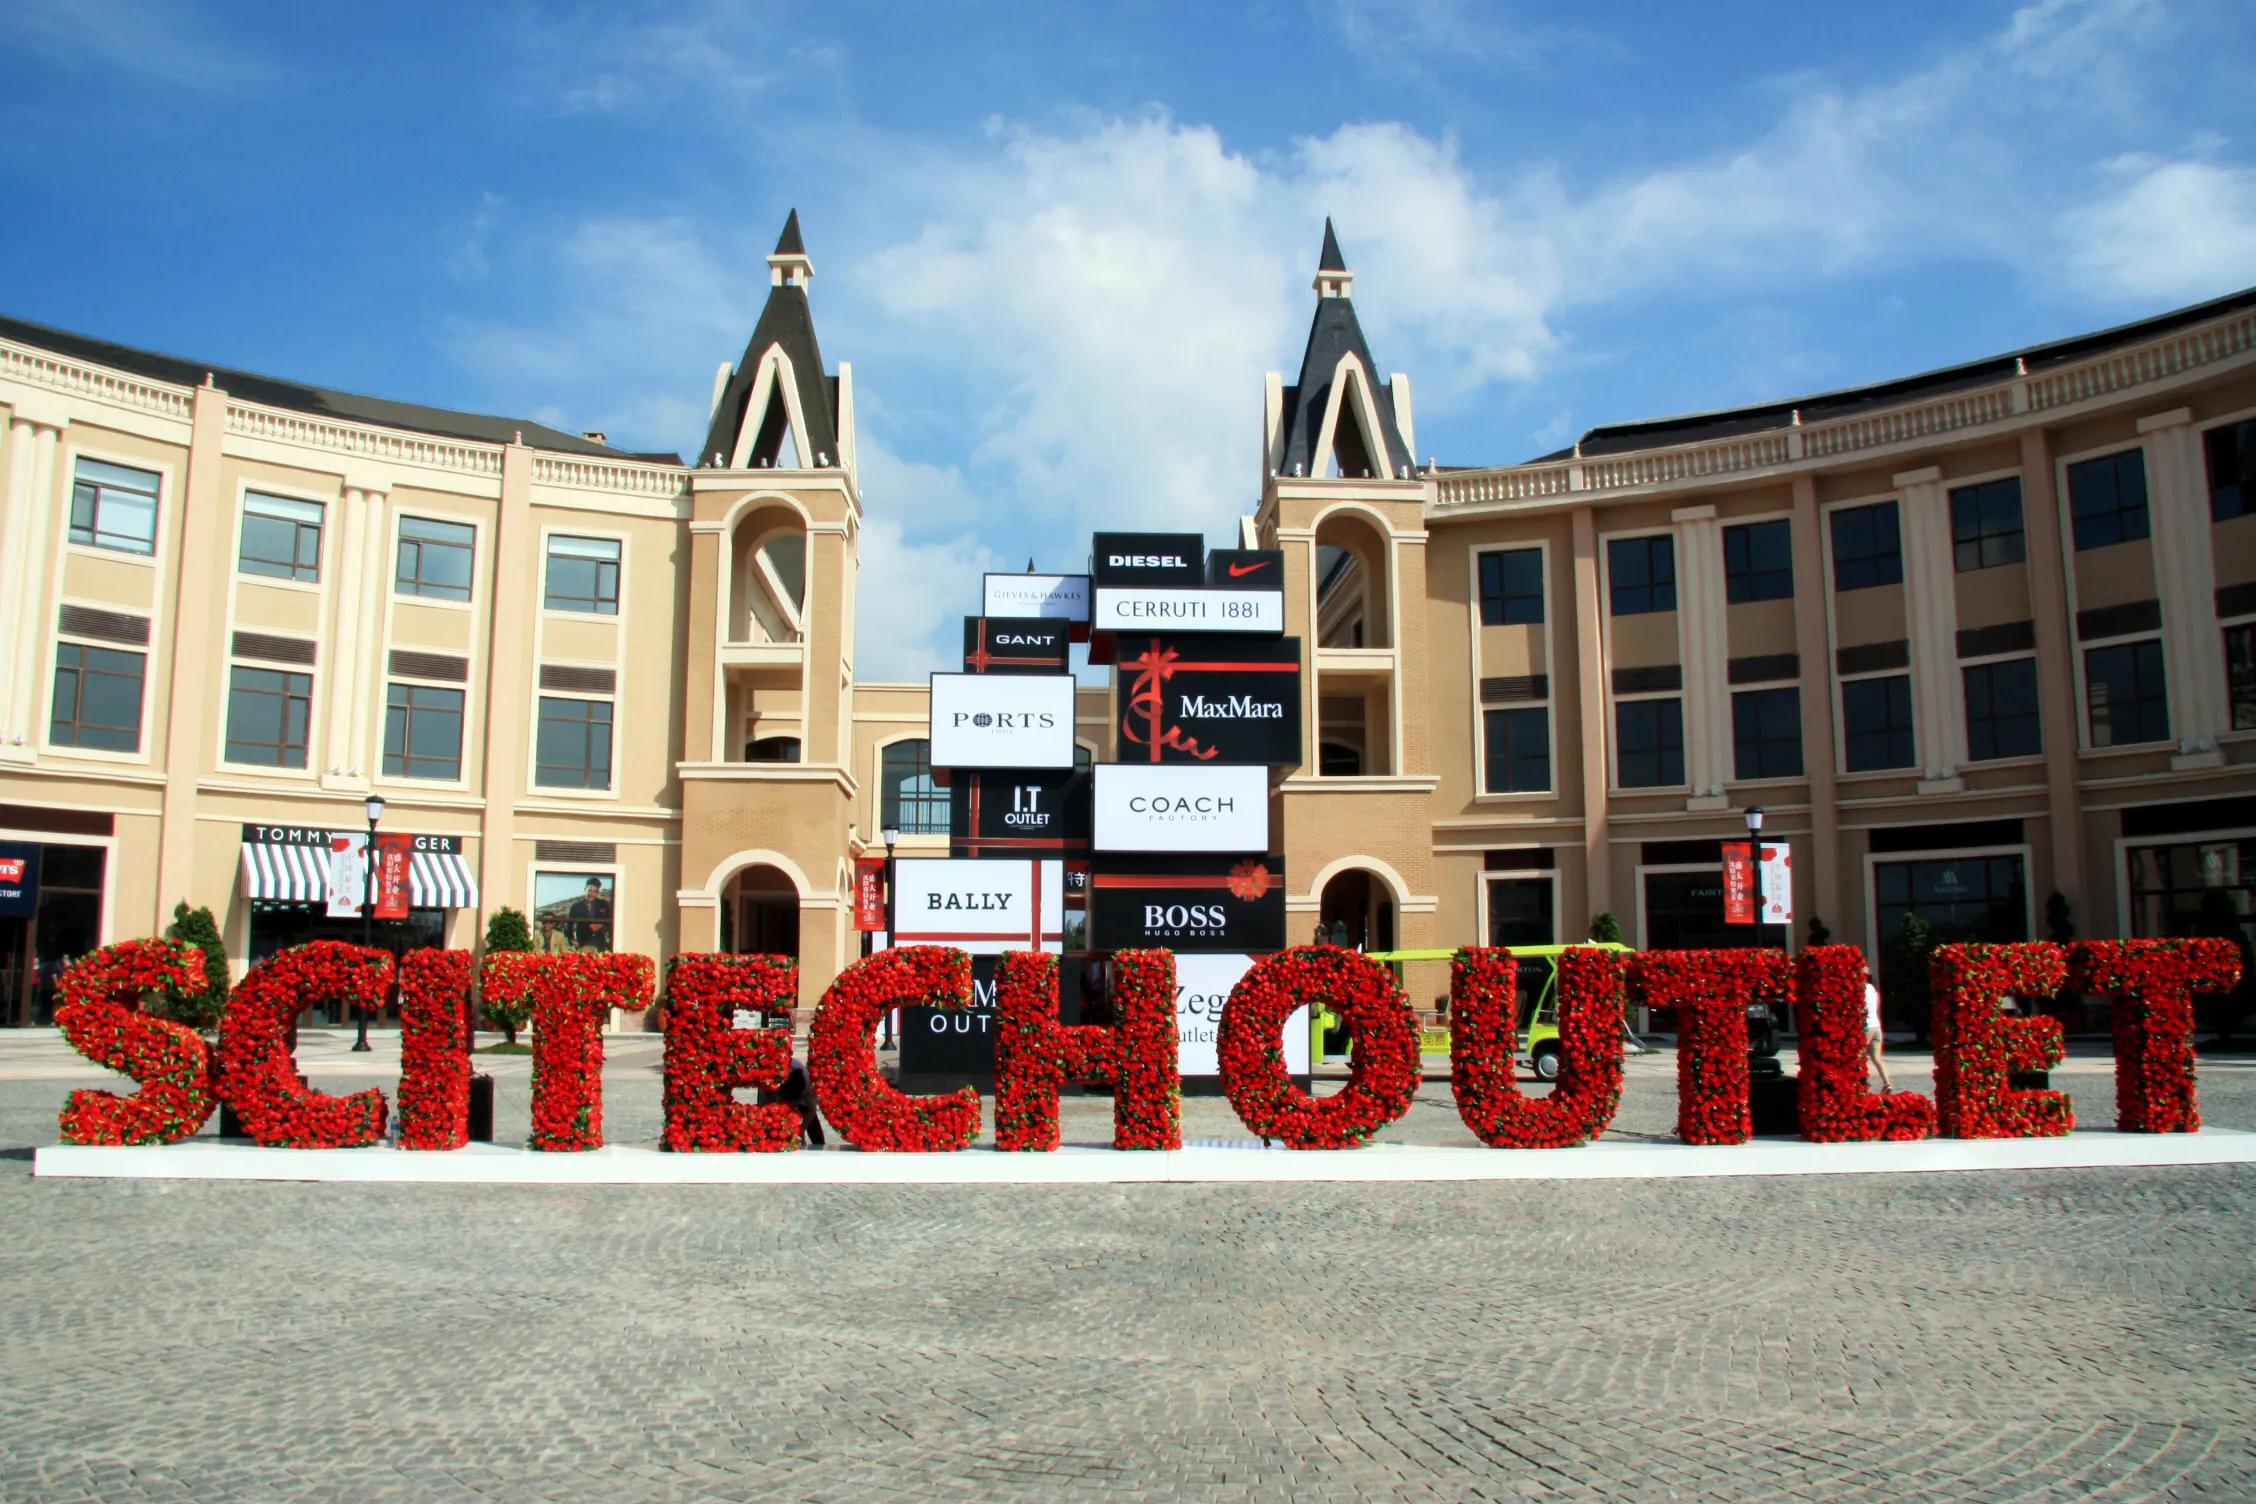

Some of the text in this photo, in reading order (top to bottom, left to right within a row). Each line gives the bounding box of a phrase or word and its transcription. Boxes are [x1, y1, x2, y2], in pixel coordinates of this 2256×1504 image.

[1109, 556, 1187, 568] DIESEL
[1040, 591, 1081, 600] HAWKES
[1116, 600, 1260, 618] CERRUTI 1881
[996, 634, 1055, 646] GANT
[1180, 695, 1283, 719] MaxMara
[952, 712, 1055, 728] PORTS
[1014, 786, 1042, 812] I.T
[1129, 797, 1233, 813] COACH
[1004, 813, 1050, 824] OUTLET
[256, 827, 335, 844] TOMMY
[927, 893, 1013, 910] BALLY
[1144, 904, 1226, 928] BOSS
[1144, 929, 1225, 937] HUGO BOSS
[1176, 986, 1227, 1023] Zeg
[930, 1014, 991, 1033] OUT
[1177, 1026, 1217, 1043] utlet
